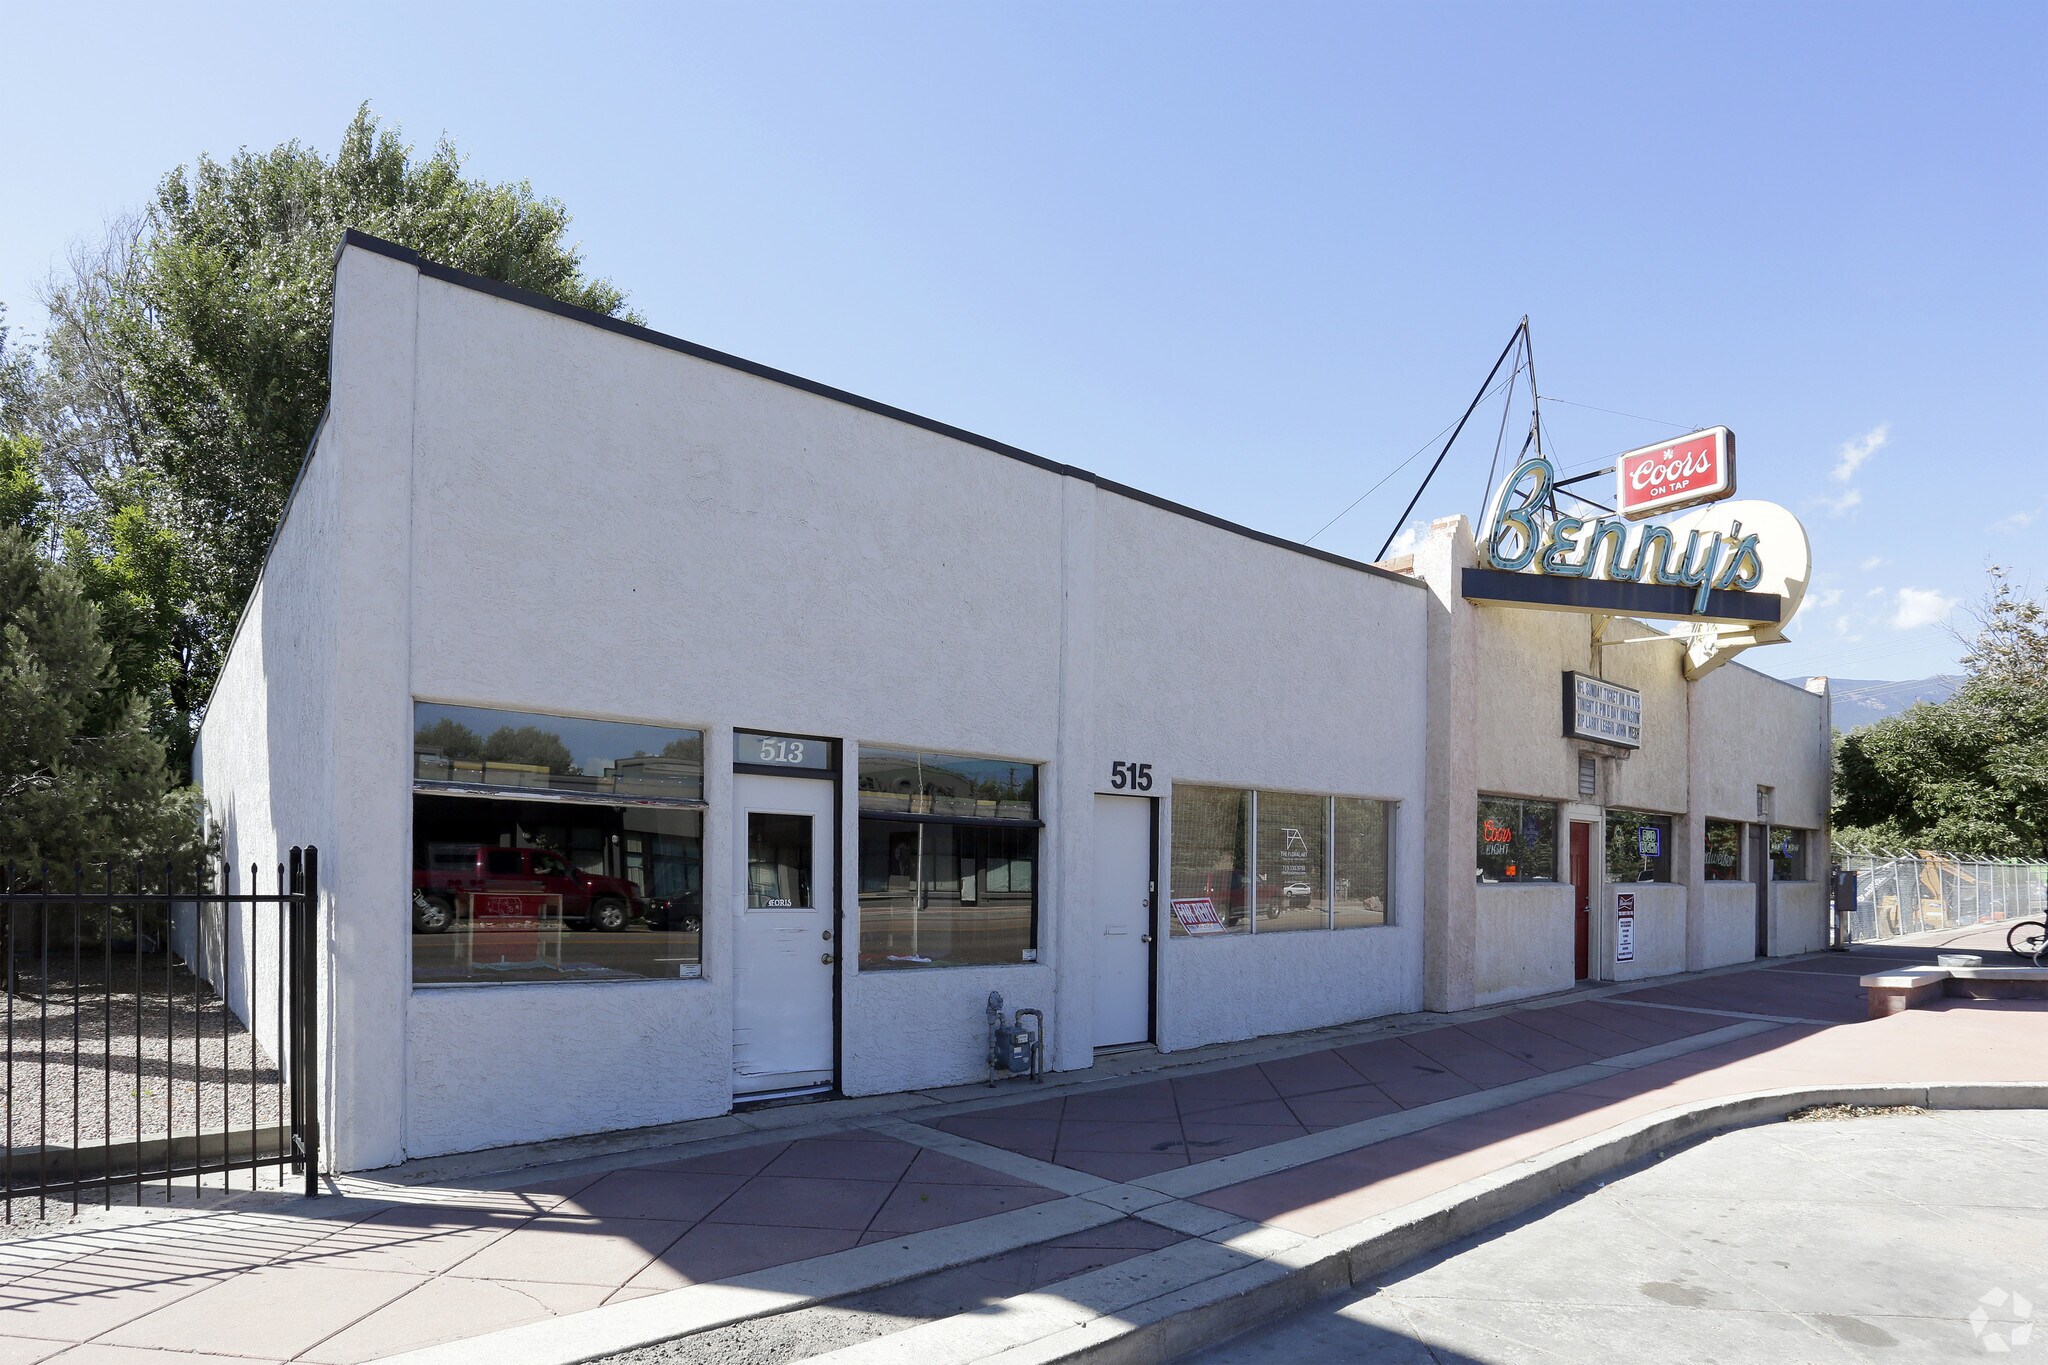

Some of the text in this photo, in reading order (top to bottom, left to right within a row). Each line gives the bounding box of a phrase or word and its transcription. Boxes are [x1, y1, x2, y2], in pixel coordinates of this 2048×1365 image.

[1629, 449, 1711, 490] Coors
[1650, 480, 1690, 496] ON TAP
[1487, 457, 1763, 615] Benny's
[760, 739, 804, 763] 513
[1111, 761, 1153, 791] 515
[1484, 819, 1511, 843] Coors
[1175, 902, 1217, 923] FOR RENT
